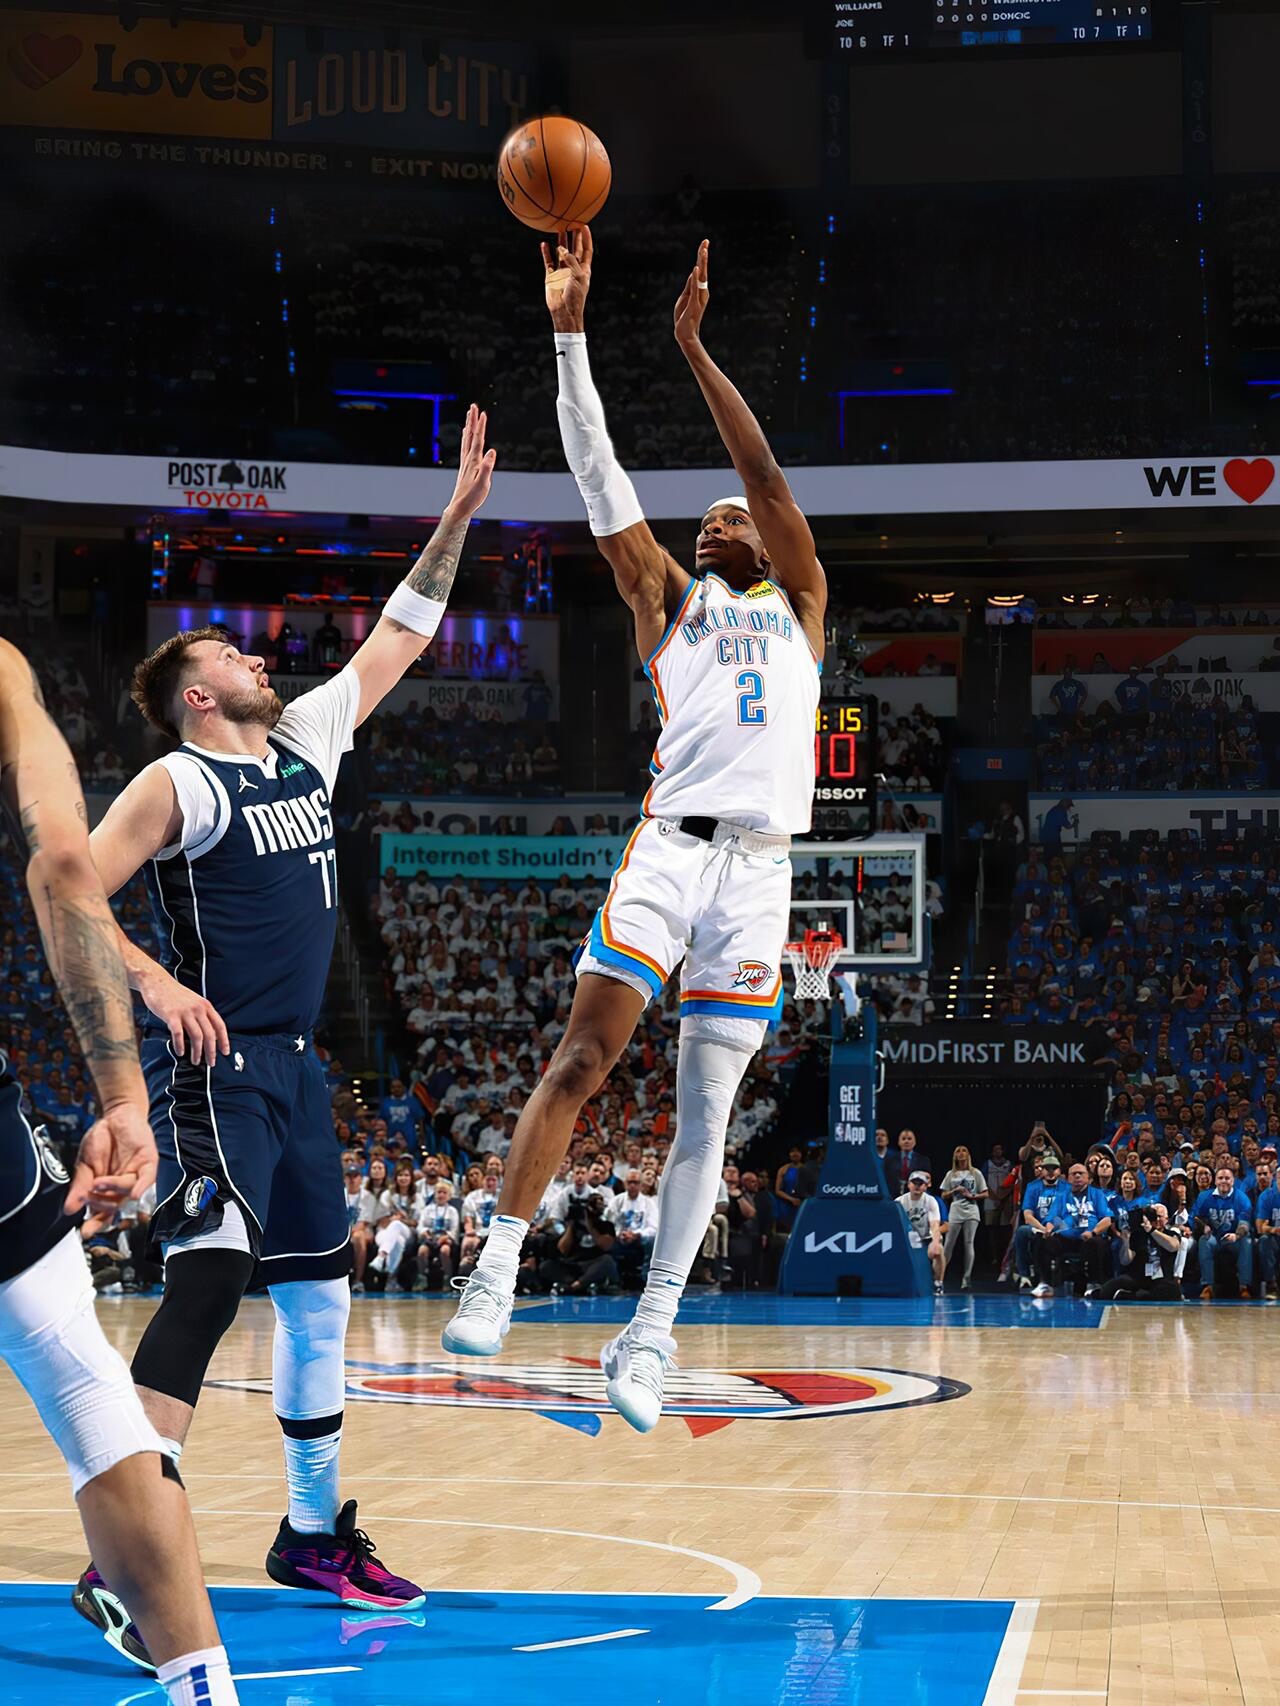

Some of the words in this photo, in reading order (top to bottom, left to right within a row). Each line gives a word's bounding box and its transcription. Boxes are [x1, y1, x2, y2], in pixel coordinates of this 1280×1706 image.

[840, 37, 852, 48] TO
[859, 36, 867, 48] 6
[882, 35, 894, 46] TF
[1072, 27, 1085, 38] TO
[1094, 27, 1100, 38] 7
[1116, 25, 1127, 37] TF
[286, 48, 406, 127] LOUD
[426, 52, 528, 129] CITY
[34, 138, 122, 159] BRING
[131, 142, 186, 162] THE
[192, 147, 329, 171] THUNDER
[370, 157, 432, 177] EXIT
[168, 462, 217, 487] POST
[248, 466, 287, 490] OAK
[1143, 466, 1216, 497] WE
[183, 491, 268, 509] TOYOTA
[717, 637, 769, 665] CITY
[735, 669, 767, 726] 2
[815, 706, 862, 732] :15
[279, 761, 306, 779] hime
[241, 788, 334, 856] MAVS
[393, 846, 490, 865] Internet
[496, 847, 613, 867] Shouldn't
[839, 1085, 861, 1103] GET
[839, 1104, 861, 1122] THE
[844, 1123, 866, 1145] App
[822, 1184, 855, 1195] Google
[856, 1184, 879, 1194] Pixel
[804, 1231, 892, 1253] KIA
